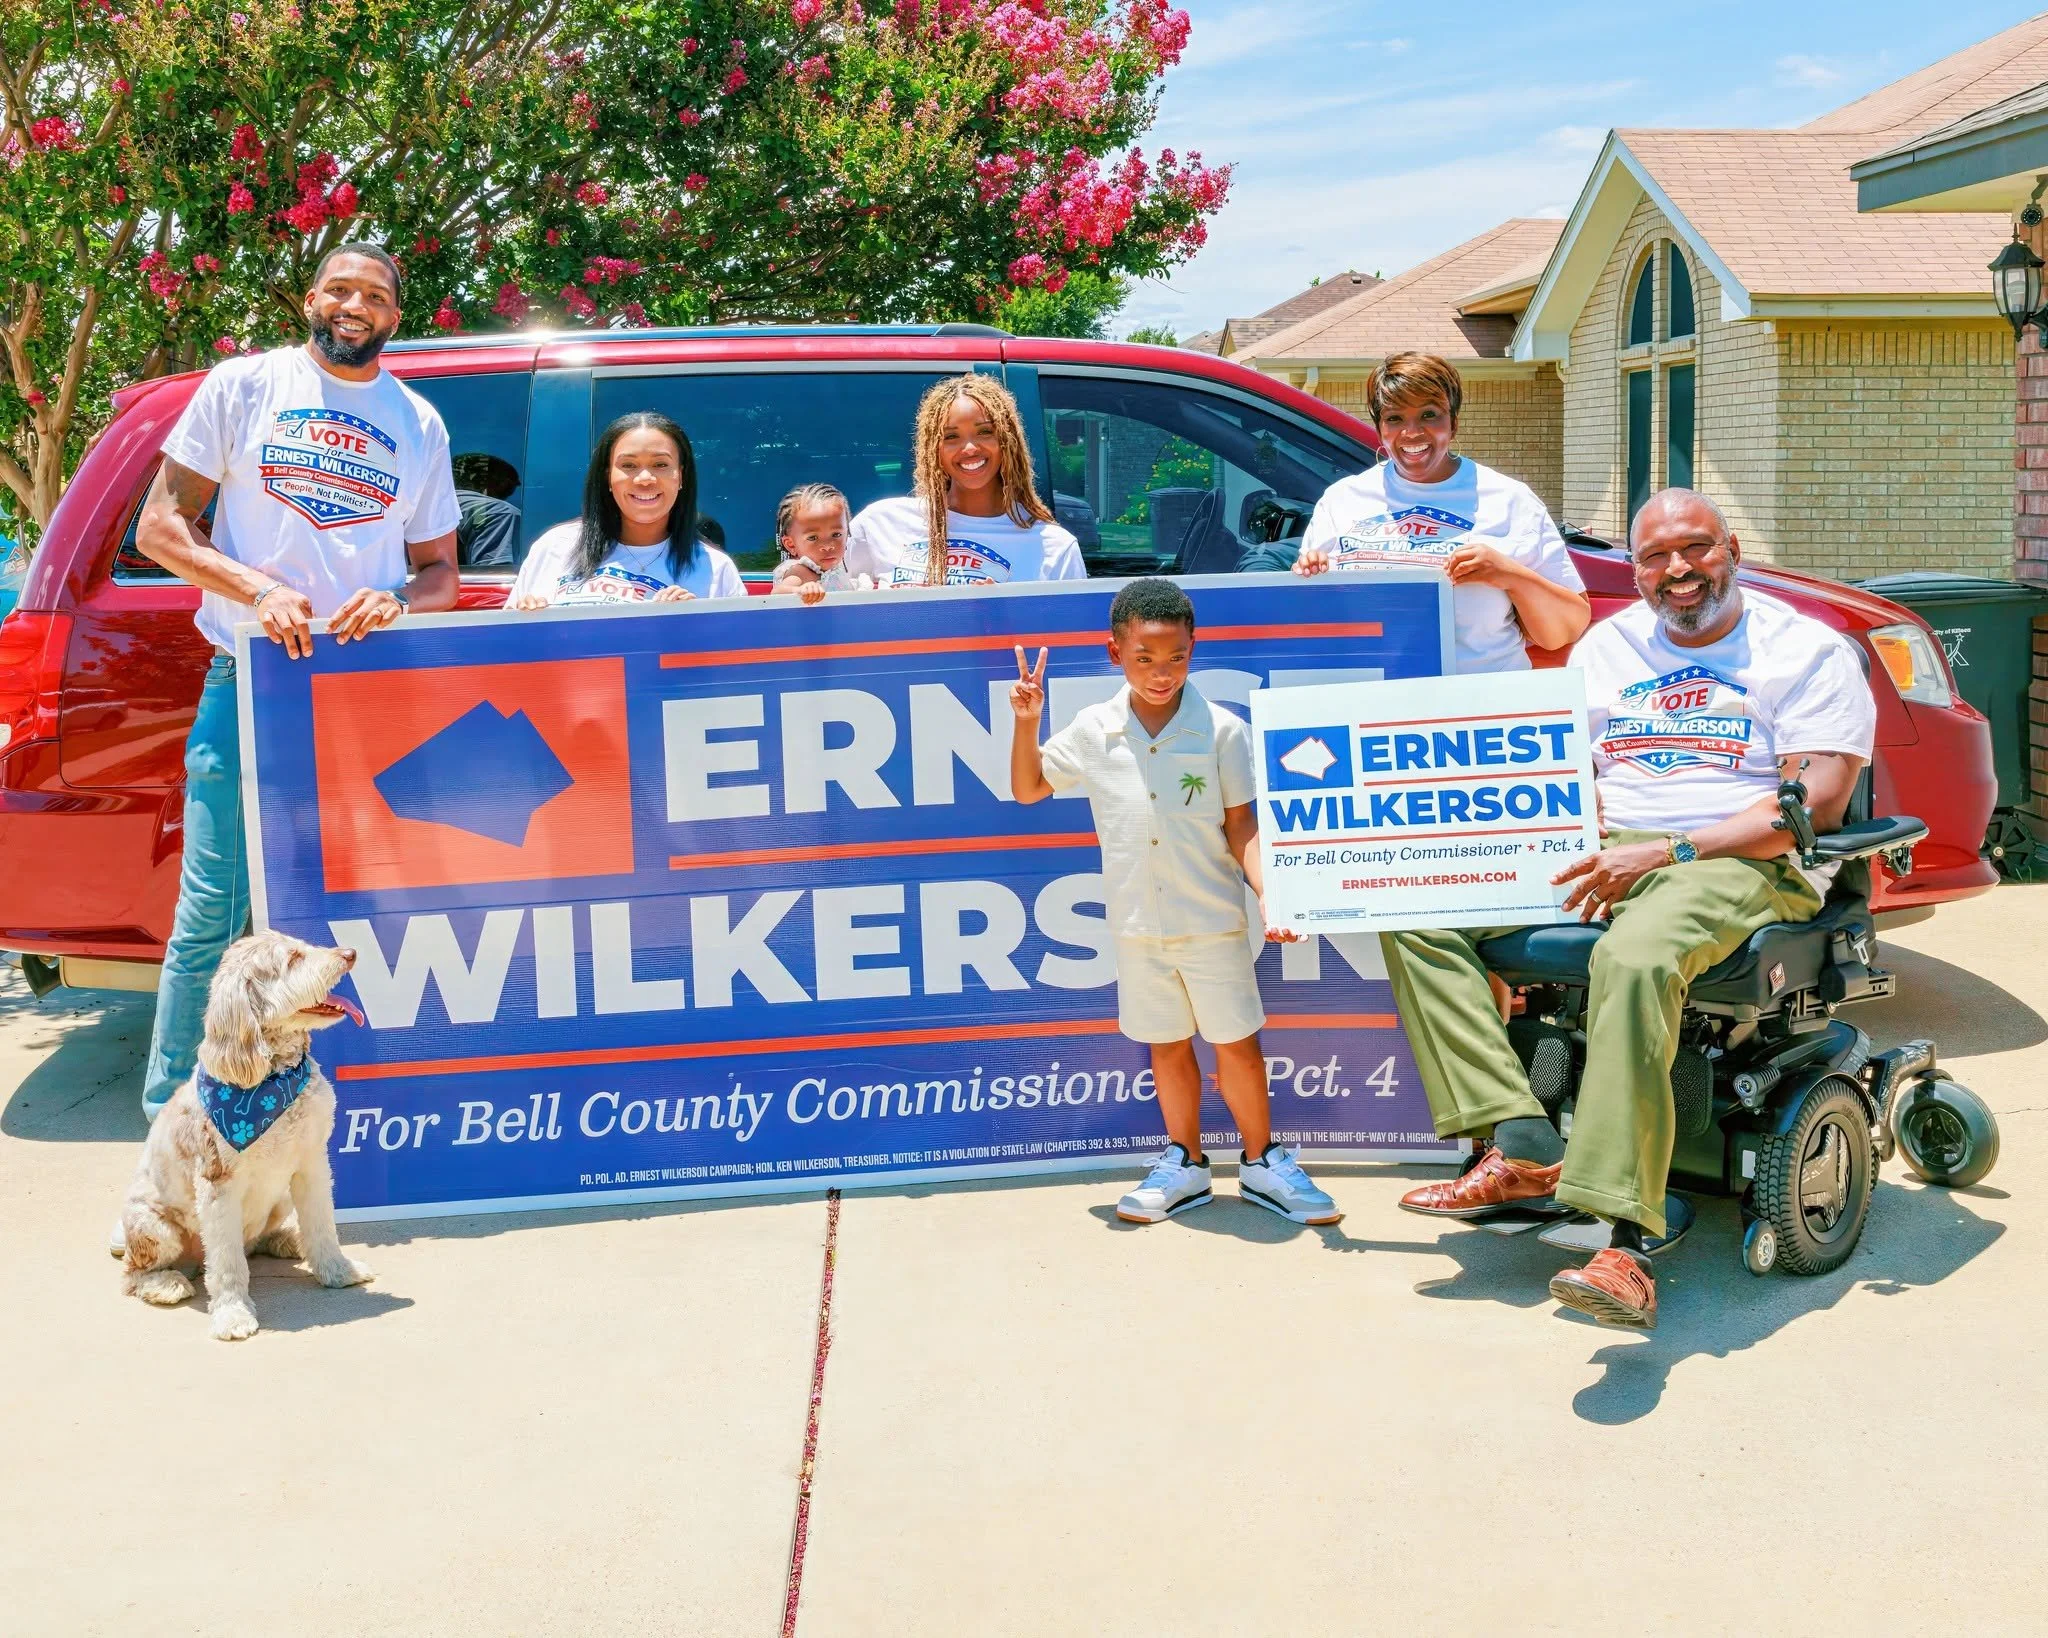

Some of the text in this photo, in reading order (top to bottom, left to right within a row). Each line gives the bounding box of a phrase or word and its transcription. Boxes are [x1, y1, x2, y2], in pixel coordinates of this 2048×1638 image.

[309, 425, 368, 455] VOTE
[324, 447, 344, 458] for
[265, 447, 396, 492] ERNEST WILKERSON
[273, 466, 382, 498] Bell County Commissioner Pct. 4
[284, 482, 367, 508] People, Not Politics!
[1384, 523, 1440, 536] VOTE
[1343, 538, 1388, 551] ERNEST
[945, 554, 983, 569] OTE
[895, 568, 925, 582] ERNE
[588, 581, 646, 600] VOTE
[1651, 688, 1709, 711] VOTE
[1665, 710, 1683, 719] for
[1608, 719, 1745, 737] ERNEST WILKERSON
[1360, 723, 1575, 772] ERNEST
[1612, 741, 1626, 750] Bell
[1627, 740, 1652, 749] County
[1701, 740, 1718, 749] Pct.
[1720, 741, 1727, 749] 4
[1269, 781, 1582, 832] WILKERSON
[1273, 838, 1585, 868] For Bell County Commissioner Pct. 4
[1342, 871, 1518, 890] ERNESTWILKERSON.COM
[338, 1056, 1398, 1153] For Bell County Commissione Pct. 4
[580, 1174, 594, 1185] PD.
[595, 1173, 613, 1184] POL.
[615, 1172, 629, 1183] AD.
[630, 1169, 660, 1182] ERNEST
[662, 1166, 708, 1180] WILKERSON
[709, 1163, 754, 1177] CAMPAIGN;
[756, 1162, 775, 1174] HON.
[777, 1161, 793, 1172] KEN
[794, 1157, 842, 1171] WILKERSON,
[843, 1154, 891, 1167] TREASURER.
[893, 1151, 923, 1164] NOTICE:
[924, 1151, 932, 1162] IT
[934, 1150, 941, 1161] IS
[942, 1150, 949, 1160] A
[949, 1146, 989, 1160] VIOLATION
[991, 1145, 1001, 1156] OF
[1001, 1143, 1024, 1156] STATE
[1026, 1142, 1042, 1154] LAW
[1044, 1137, 1087, 1154] (CHAPTERS
[1088, 1137, 1103, 1149] 392
[1104, 1138, 1111, 1148] &
[1112, 1136, 1130, 1149] 393,
[1131, 1134, 1172, 1147] TRANSPOR
[1200, 1132, 1223, 1144] CODE)
[1225, 1132, 1236, 1143] TO
[1282, 1132, 1301, 1142] SIGN
[1303, 1132, 1311, 1142] IN
[1312, 1132, 1328, 1142] THE
[1329, 1132, 1387, 1143] RIGHT-OF-WAY
[1388, 1132, 1398, 1143] OF
[1399, 1133, 1406, 1143] A
